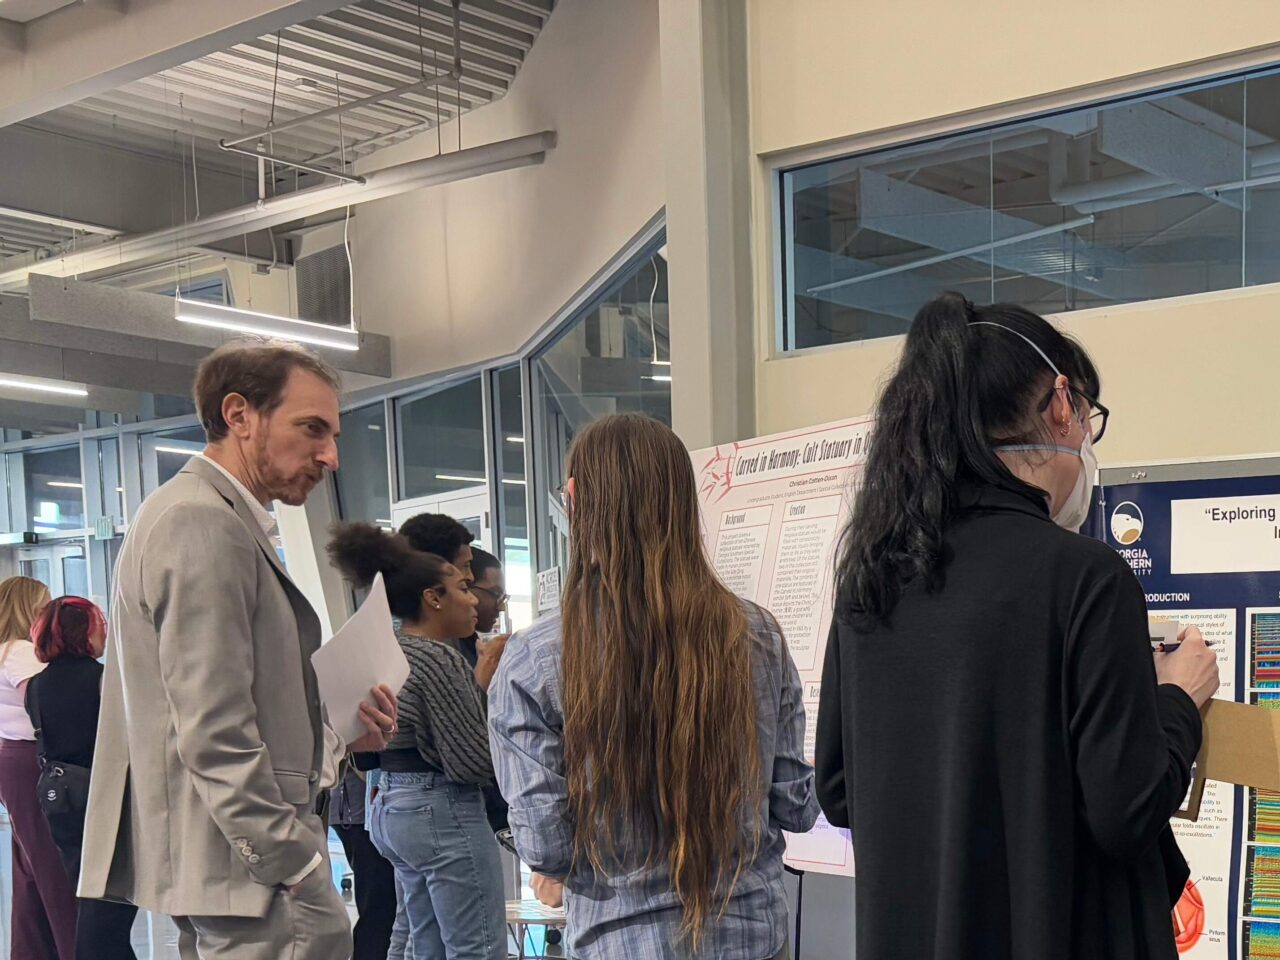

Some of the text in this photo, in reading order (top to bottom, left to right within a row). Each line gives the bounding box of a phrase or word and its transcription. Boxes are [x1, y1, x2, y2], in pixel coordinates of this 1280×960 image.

[735, 452, 760, 476] Carved
[759, 451, 768, 473] in
[768, 448, 801, 471] Harmony:
[802, 440, 819, 465] Cult
[819, 438, 853, 462] Statuary
[853, 433, 863, 455] in
[1145, 593, 1190, 602] RODUCTION
